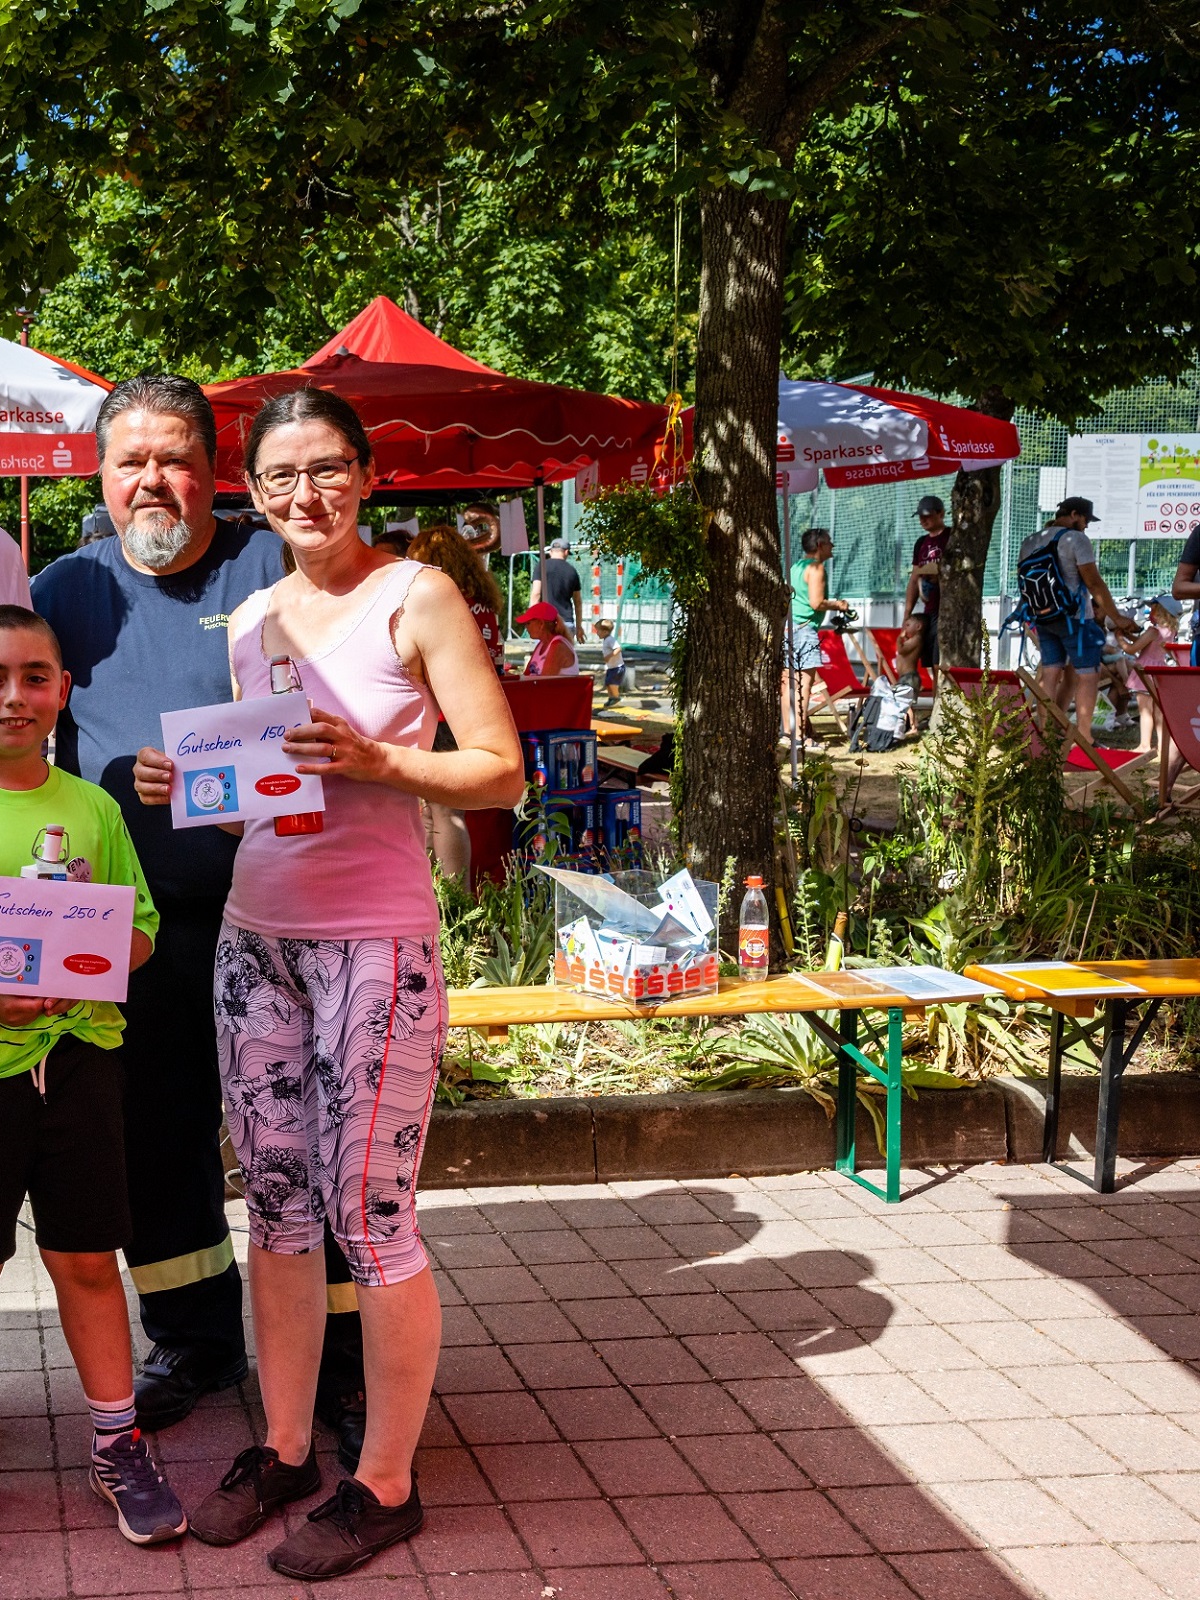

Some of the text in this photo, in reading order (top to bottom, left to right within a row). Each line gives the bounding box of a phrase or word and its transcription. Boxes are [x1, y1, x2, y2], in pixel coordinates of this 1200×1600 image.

[803, 443, 883, 464] Sparkasse
[950, 439, 995, 456] Sparkasse
[176, 724, 286, 756] Gutschein 150
[62, 906, 96, 920] 250
[102, 908, 115, 920] €
